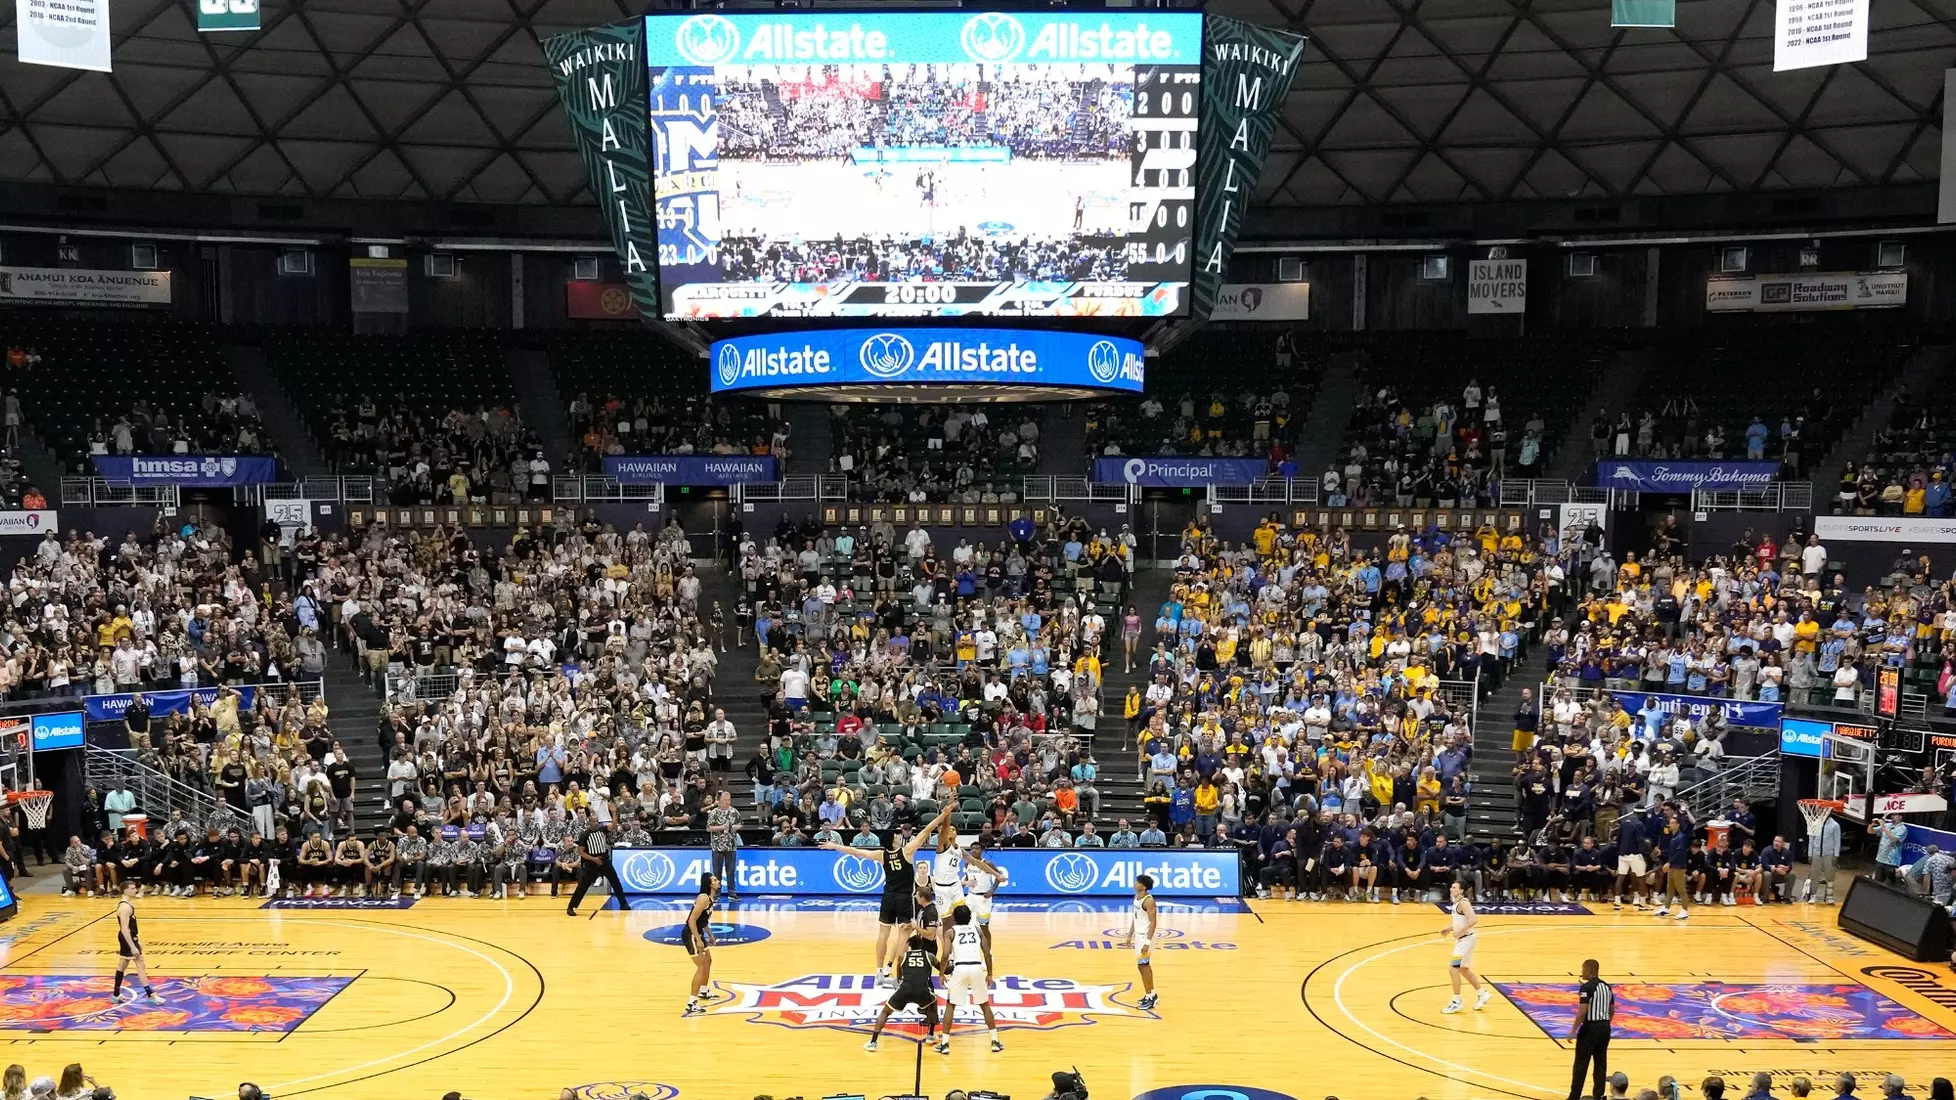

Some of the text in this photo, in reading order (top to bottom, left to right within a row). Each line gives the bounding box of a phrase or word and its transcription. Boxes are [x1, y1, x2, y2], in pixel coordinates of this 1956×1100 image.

[49, 2, 65, 10] NCAA
[76, 6, 94, 14] Round
[1808, 1, 1823, 9] NCAA
[78, 17, 96, 26] Round
[1807, 13, 1823, 21] NCAA
[1834, 9, 1853, 17] Round
[1806, 24, 1822, 33] NCAA
[1823, 23, 1832, 31] 1st
[1833, 20, 1852, 29] Round
[743, 23, 889, 60] Allstate
[1028, 23, 1173, 60] Allstate
[1805, 36, 1821, 45] NCAA
[1831, 32, 1850, 41] Round
[558, 42, 635, 77] WAIKIKI
[1215, 43, 1289, 76] WAIKIKI
[679, 94, 690, 116] 0
[700, 94, 711, 116] 0
[1137, 92, 1192, 115] 2 0 0
[1137, 130, 1191, 153] 3 0 0
[659, 244, 718, 266] 23 0 0
[1128, 242, 1186, 265] 55 0 0
[1473, 264, 1522, 280] ISLAND
[884, 283, 956, 304] 20:00
[1469, 282, 1525, 298] MOVERS
[1793, 282, 1847, 294] Roadway
[1793, 291, 1847, 302] Solutions
[741, 344, 831, 379] Allstate
[916, 342, 1038, 373] Allstate
[132, 457, 198, 472] hmsa
[618, 463, 677, 473] HAWAIIAN
[704, 463, 763, 473] HAWAIIAN
[1148, 463, 1214, 480] Principal
[1651, 466, 1771, 489] Tommy Bahama
[274, 504, 304, 522] 25
[102, 697, 154, 710] HAWAAN
[50, 725, 82, 737] Allstate
[1884, 800, 1906, 811] ACE
[889, 859, 903, 871] 15
[949, 857, 958, 868] 13
[957, 932, 977, 944] 23
[908, 957, 924, 967] 55
